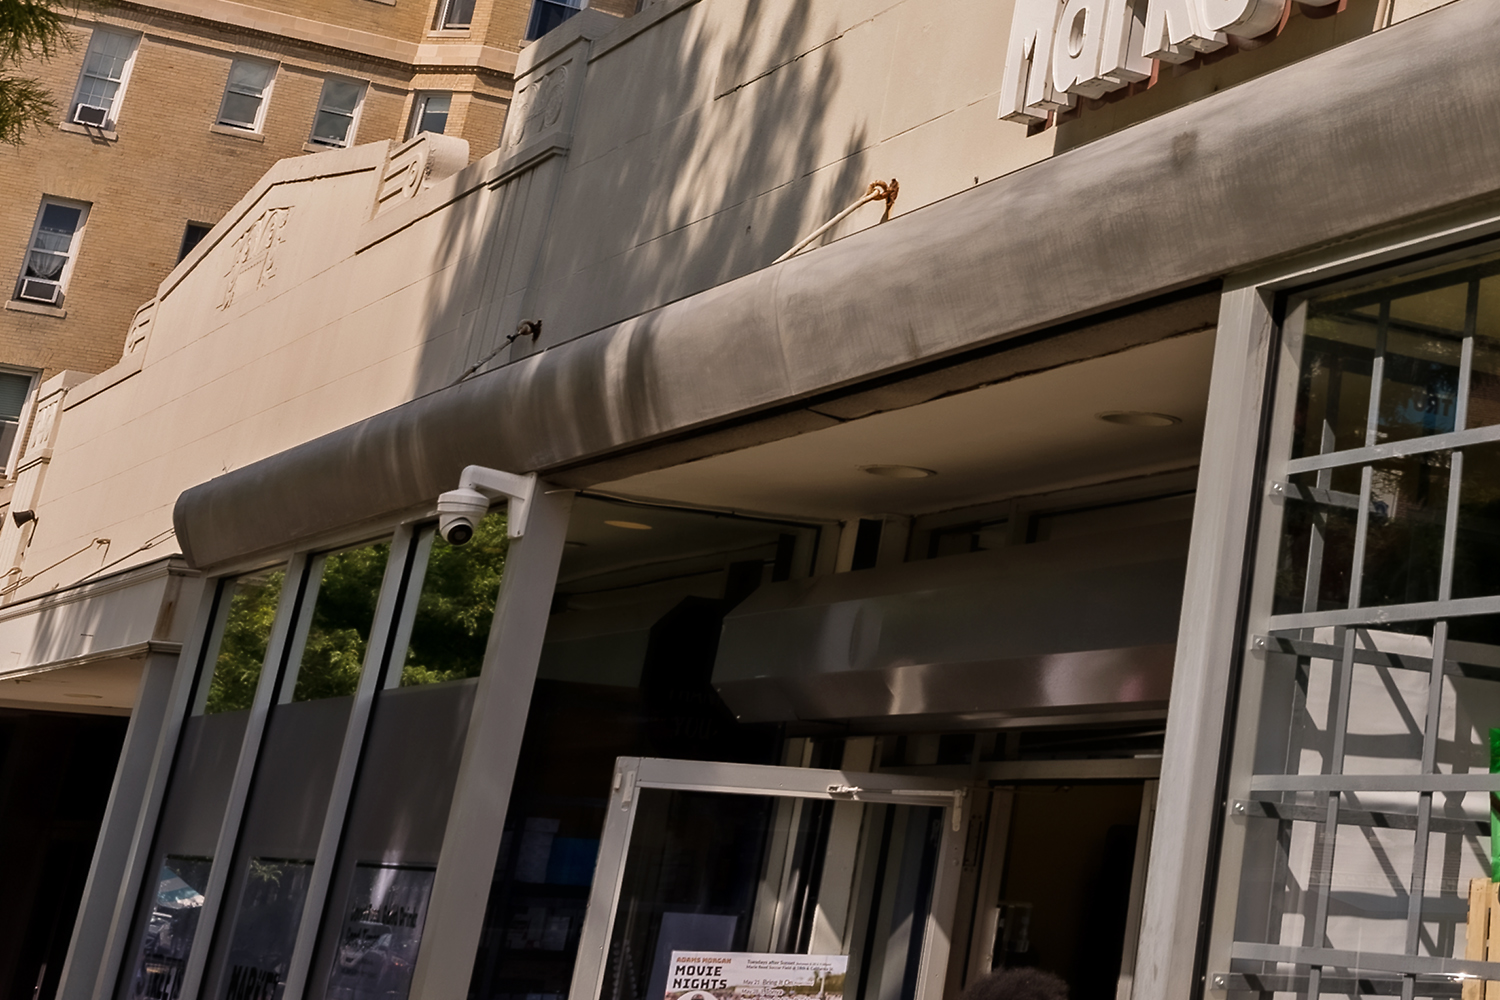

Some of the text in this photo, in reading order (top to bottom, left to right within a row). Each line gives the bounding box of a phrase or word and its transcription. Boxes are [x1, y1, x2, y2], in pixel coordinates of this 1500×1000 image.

[676, 956, 701, 964] ADAMS
[674, 965, 723, 976] MOVIE
[672, 978, 728, 989] NIGHTS
